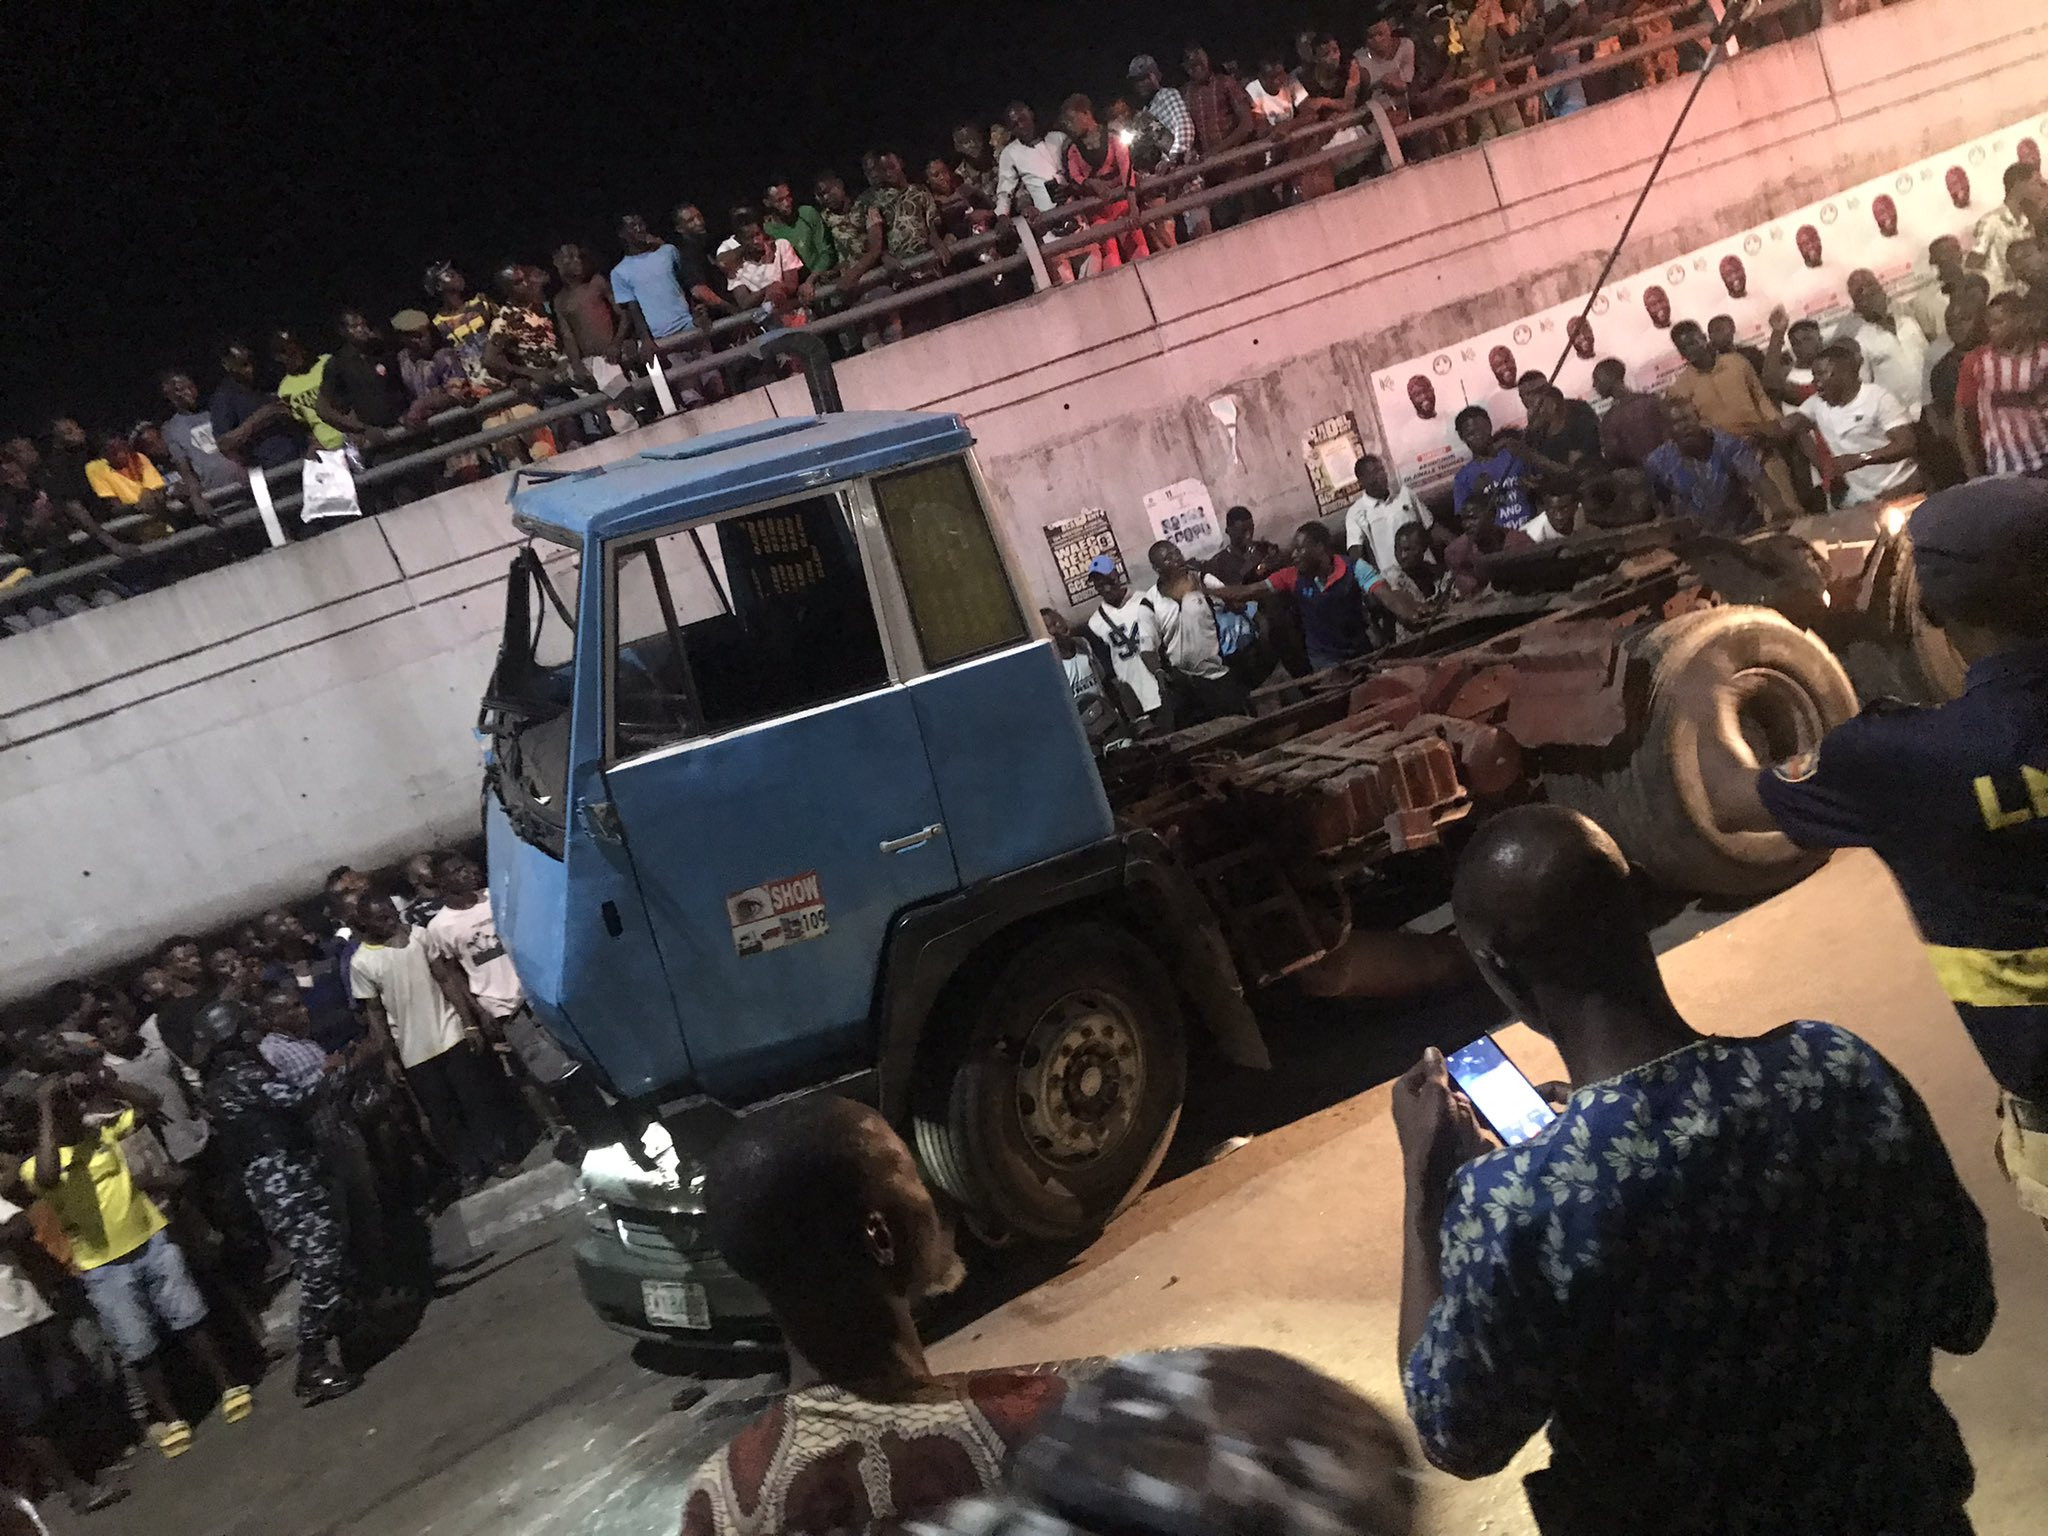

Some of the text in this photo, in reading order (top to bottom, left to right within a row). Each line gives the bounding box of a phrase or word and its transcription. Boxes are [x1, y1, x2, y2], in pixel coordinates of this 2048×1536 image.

[1500, 504, 1522, 519] AND
[1054, 535, 1098, 560] WAEC
[1058, 545, 1101, 570] NECO
[1062, 559, 1092, 581] JAM
[771, 875, 820, 910] SHOW
[802, 910, 826, 931] 109
